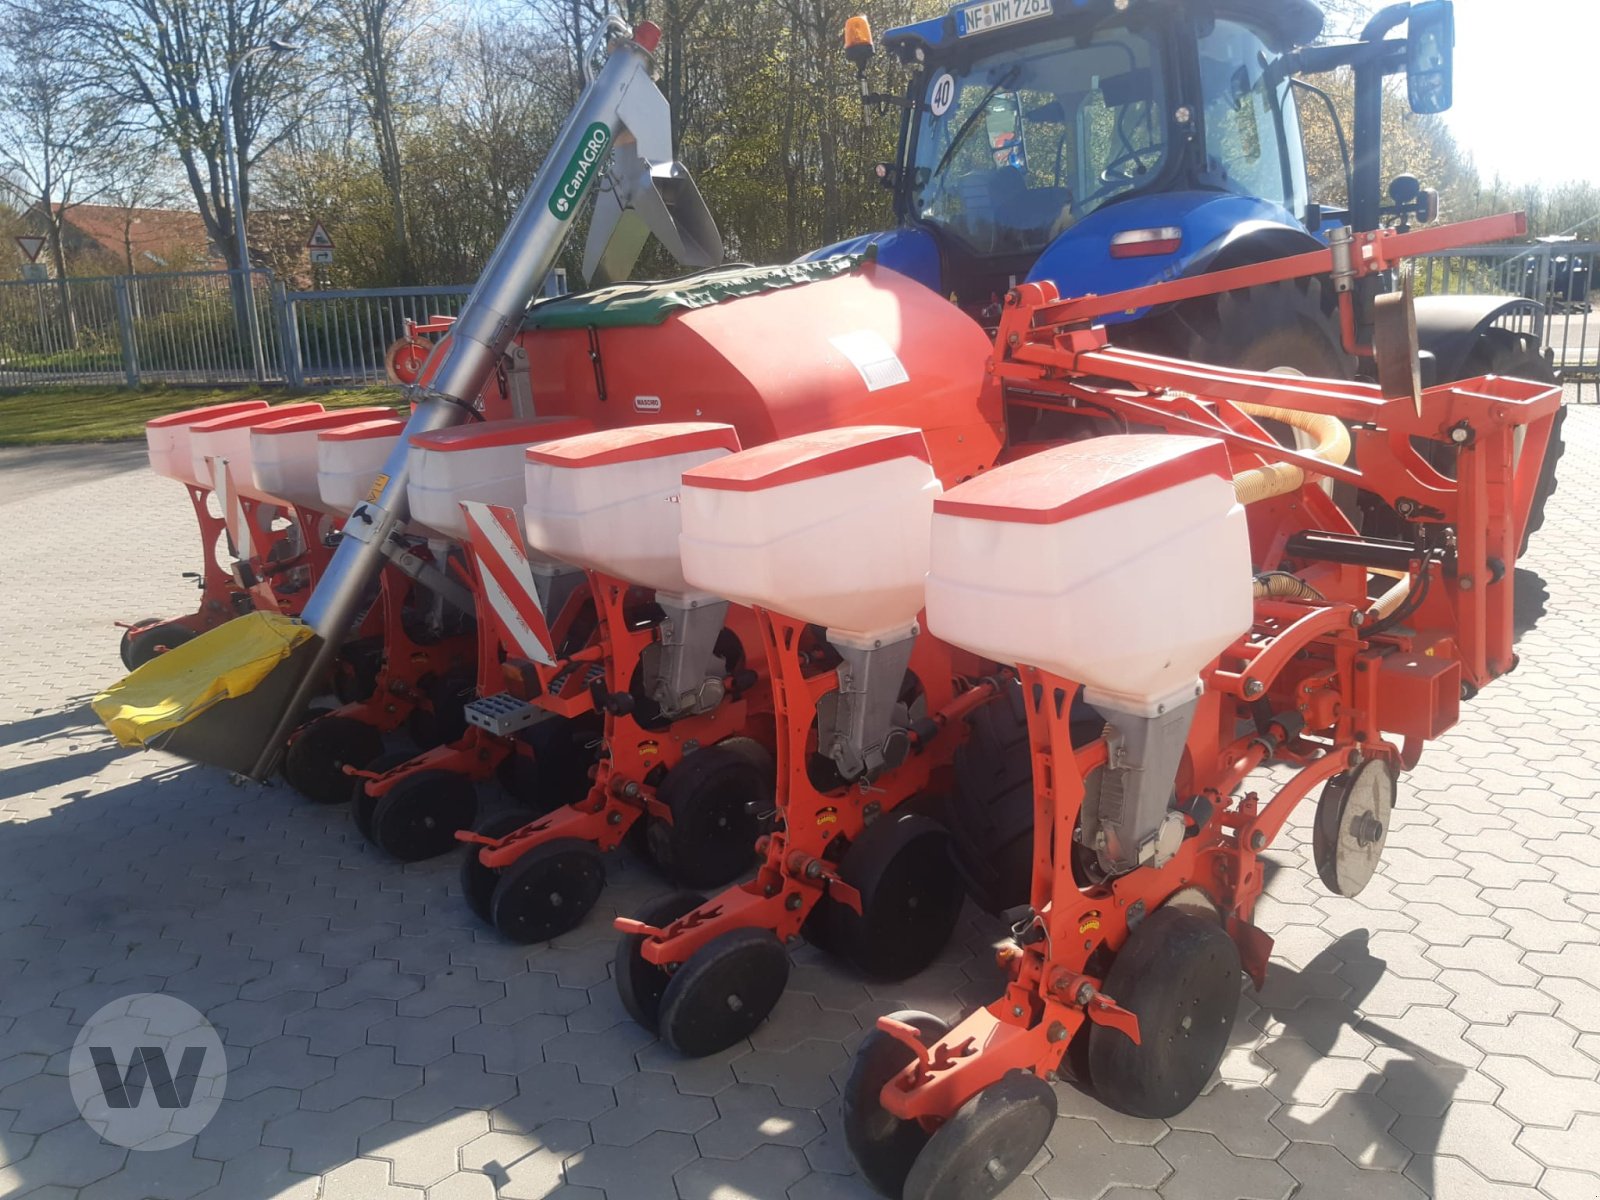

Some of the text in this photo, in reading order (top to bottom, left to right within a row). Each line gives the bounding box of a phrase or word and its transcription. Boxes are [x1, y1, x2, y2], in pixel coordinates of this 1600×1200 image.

[965, 8, 982, 31] NF
[993, 1, 1010, 24] WM
[934, 80, 950, 108] 40
[564, 129, 606, 198] CanAGRO
